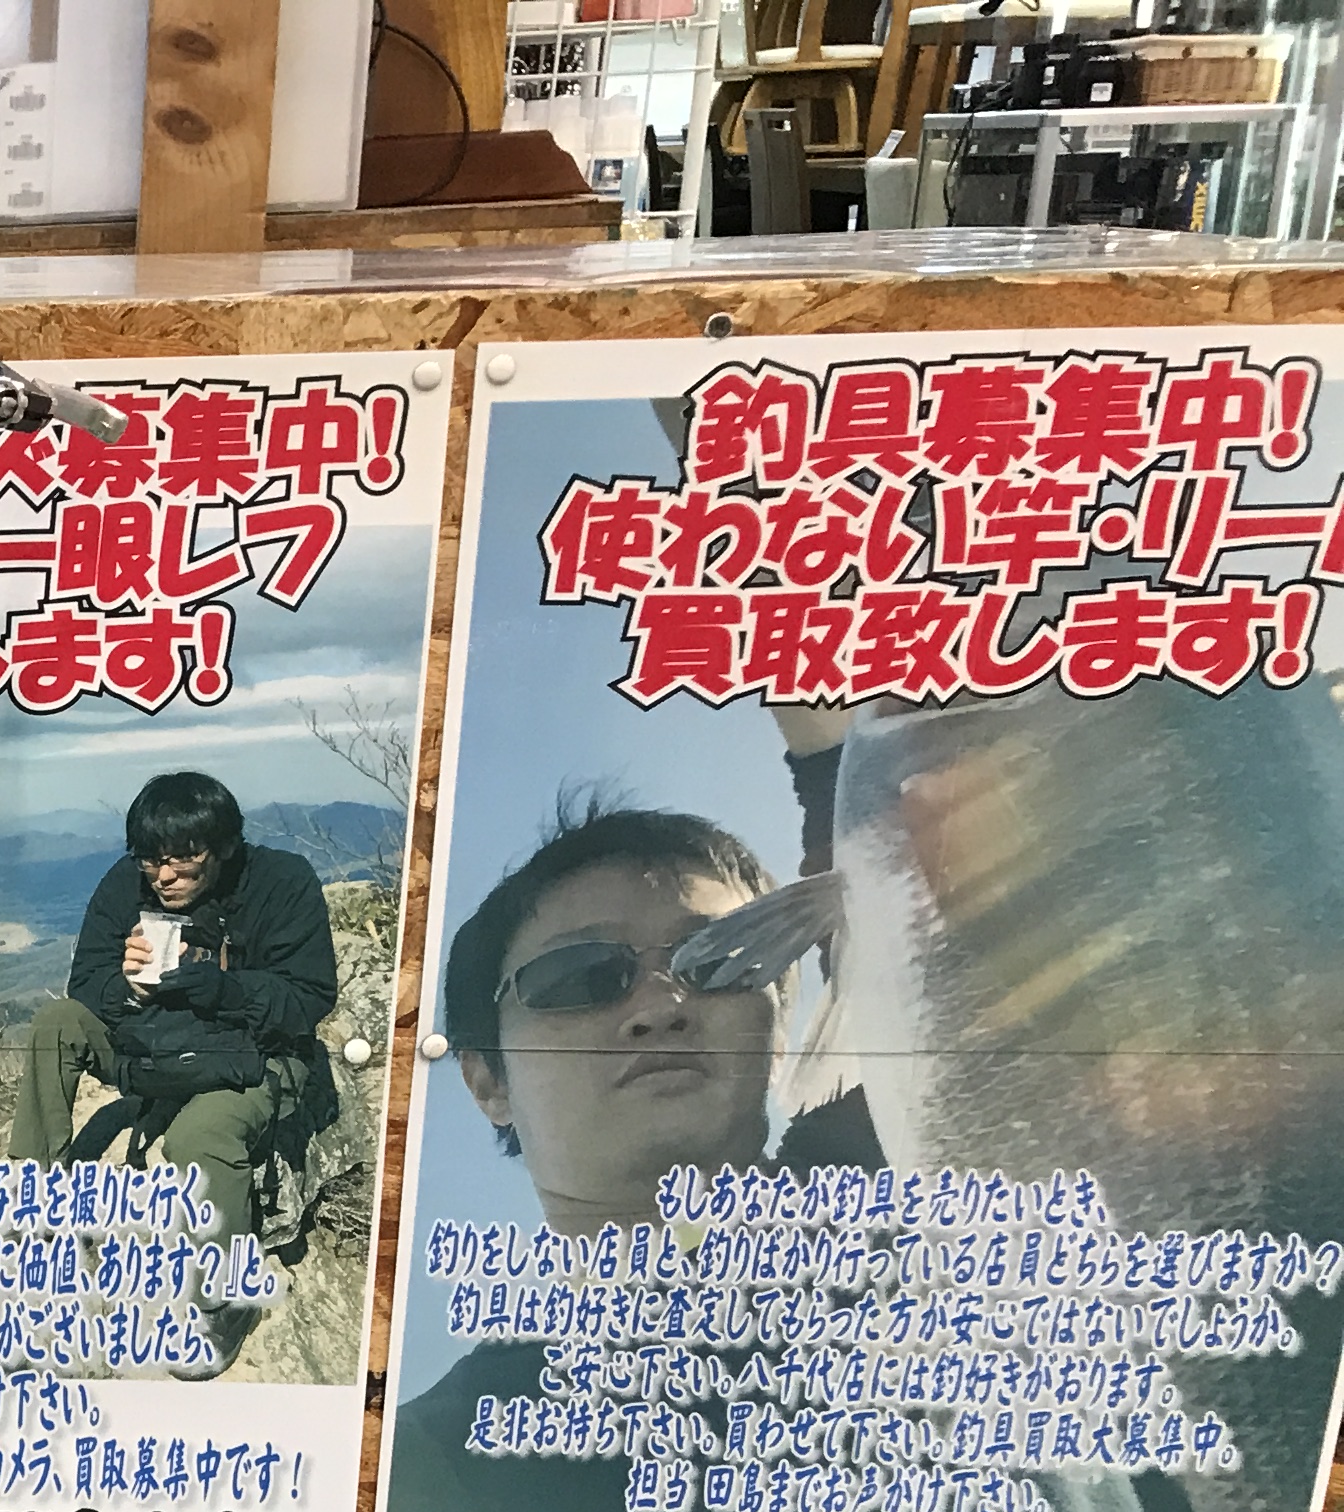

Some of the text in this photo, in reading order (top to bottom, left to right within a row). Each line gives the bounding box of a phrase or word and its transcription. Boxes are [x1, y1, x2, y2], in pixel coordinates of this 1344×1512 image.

[685, 350, 1322, 488] 釣具募集中!
[544, 470, 1344, 604] 使わない竿・リー
[615, 578, 1322, 708] 買取致します!
